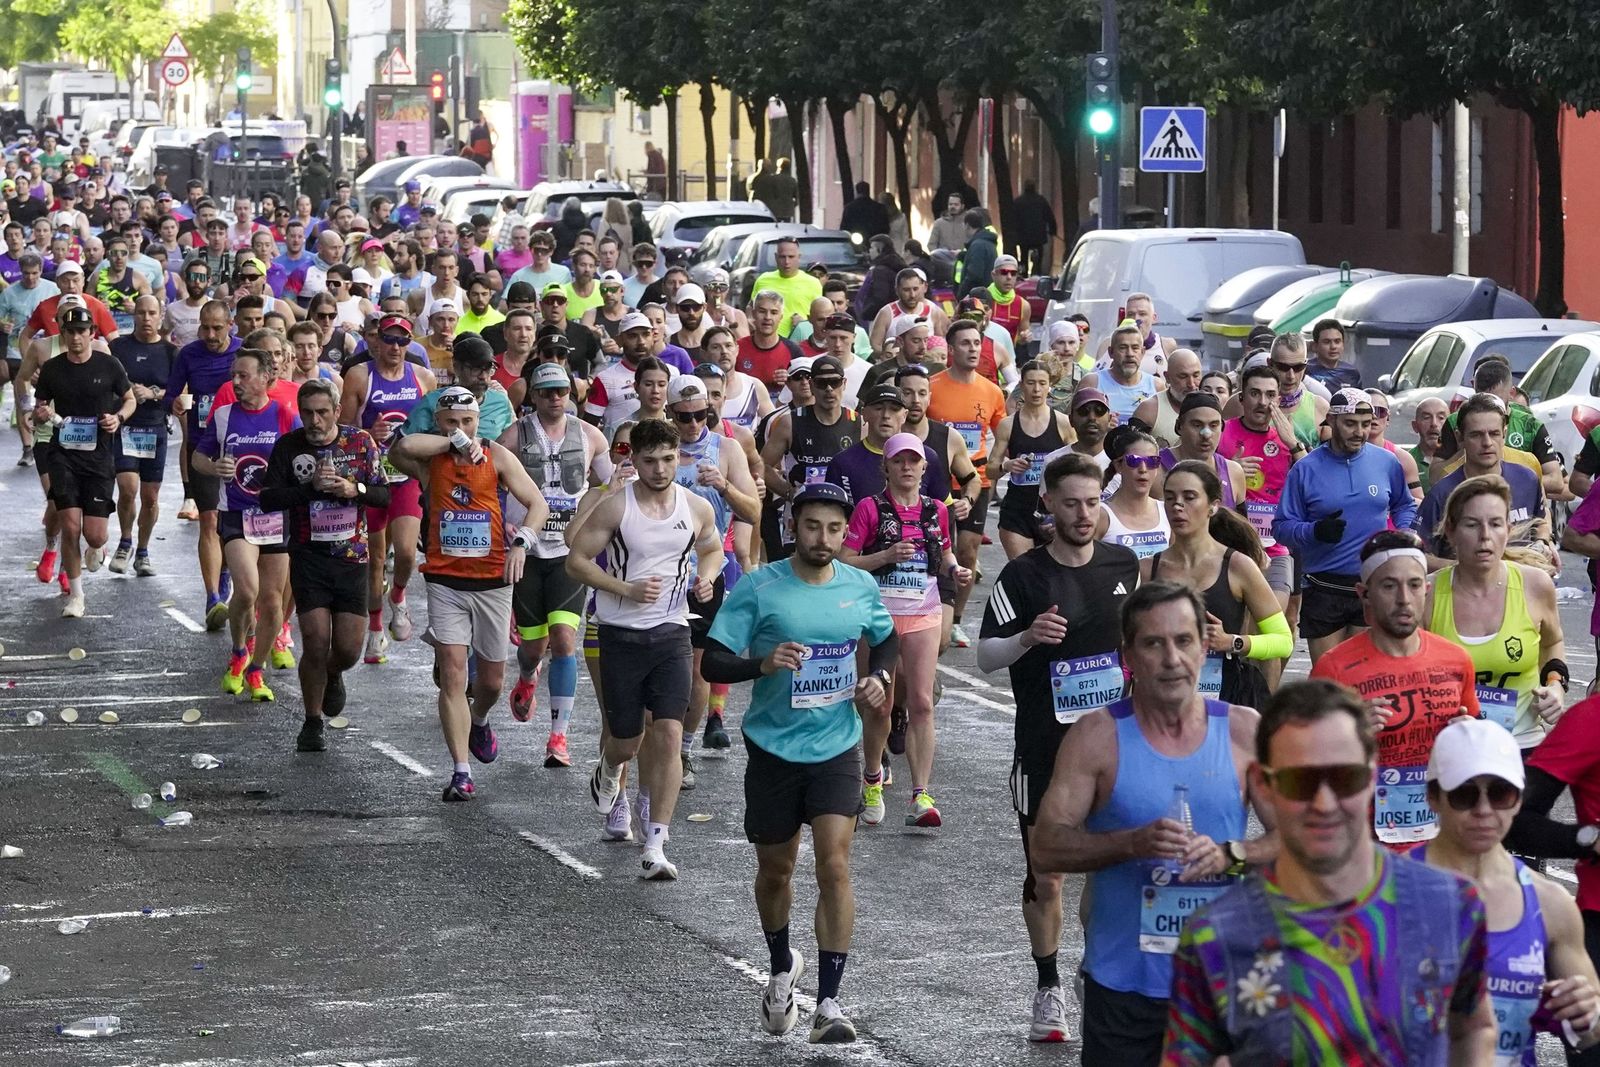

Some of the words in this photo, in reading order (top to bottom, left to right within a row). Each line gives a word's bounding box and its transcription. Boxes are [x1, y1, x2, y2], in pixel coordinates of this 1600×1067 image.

[168, 68, 185, 77] 30
[371, 389, 417, 404] Quintana
[64, 433, 93, 442] IGNACIO
[258, 430, 278, 438] Taller
[225, 432, 277, 447] Quintana
[797, 455, 813, 464] LOS
[547, 499, 571, 507] ZURICH
[1247, 504, 1273, 513] ZURICH
[457, 526, 473, 534] 6173
[440, 535, 469, 546] JESUS
[471, 536, 490, 546] G.S.
[1136, 534, 1164, 544] ZURICH
[817, 643, 851, 657] ZURICH
[1075, 656, 1113, 671] ZURICH
[818, 665, 839, 675] 7924
[793, 676, 842, 693] XANKLY
[844, 671, 853, 686] 11
[1078, 678, 1099, 690] 8731
[1057, 686, 1122, 710] MARTINEZ
[1376, 811, 1412, 826] JOSE
